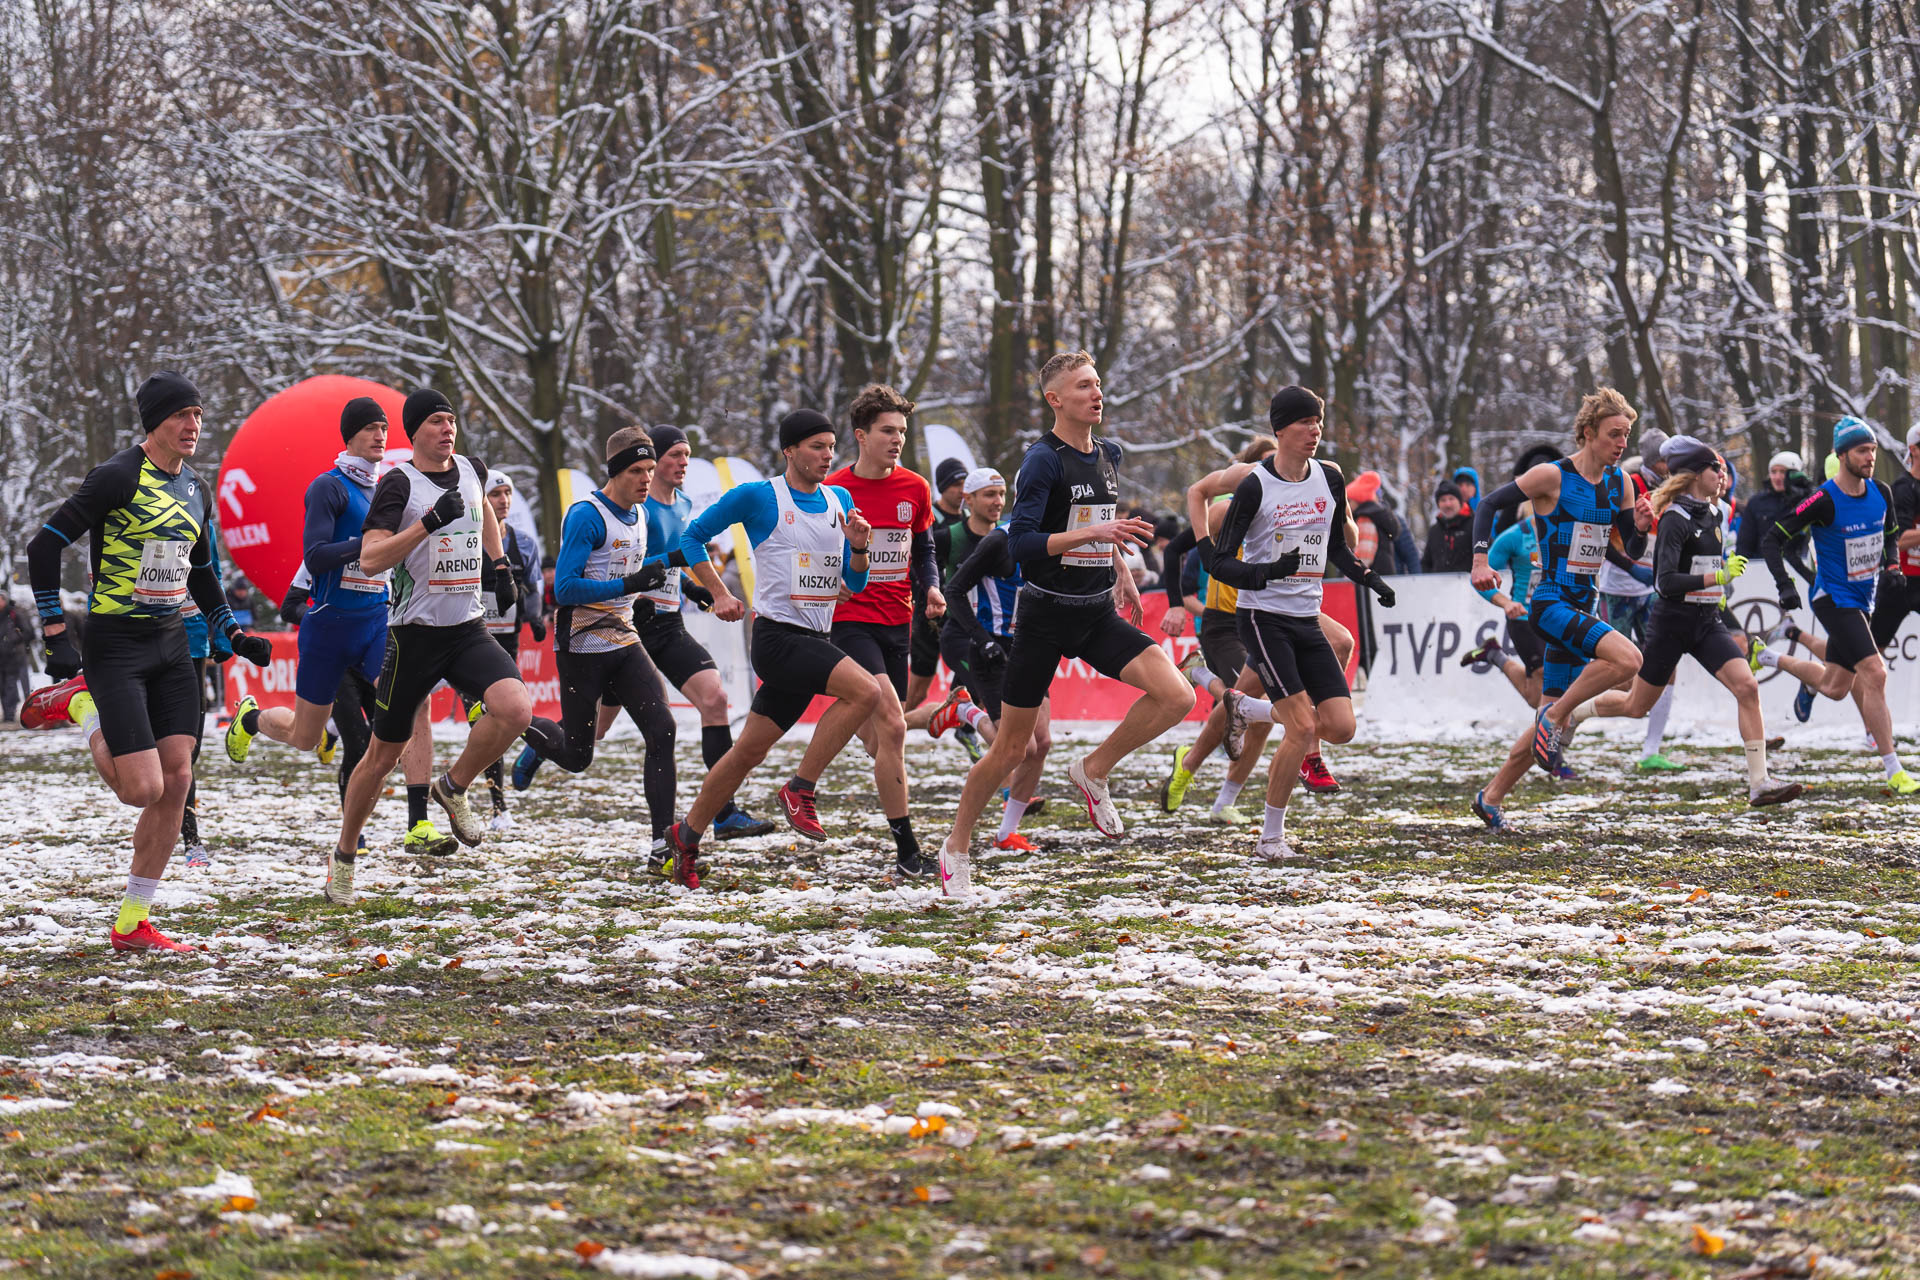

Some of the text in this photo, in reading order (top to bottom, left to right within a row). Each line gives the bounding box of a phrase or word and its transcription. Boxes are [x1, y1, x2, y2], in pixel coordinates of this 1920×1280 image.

[223, 522, 270, 548] RLEN
[466, 537, 478, 548] 69
[887, 533, 908, 543] 326
[1304, 534, 1322, 545] 460
[435, 557, 480, 573] ARENDT
[1300, 554, 1319, 566] TEK
[799, 575, 838, 589] KISZKA
[1383, 622, 1461, 675] TVP
[262, 658, 297, 693] ORL
[525, 676, 560, 707] port
